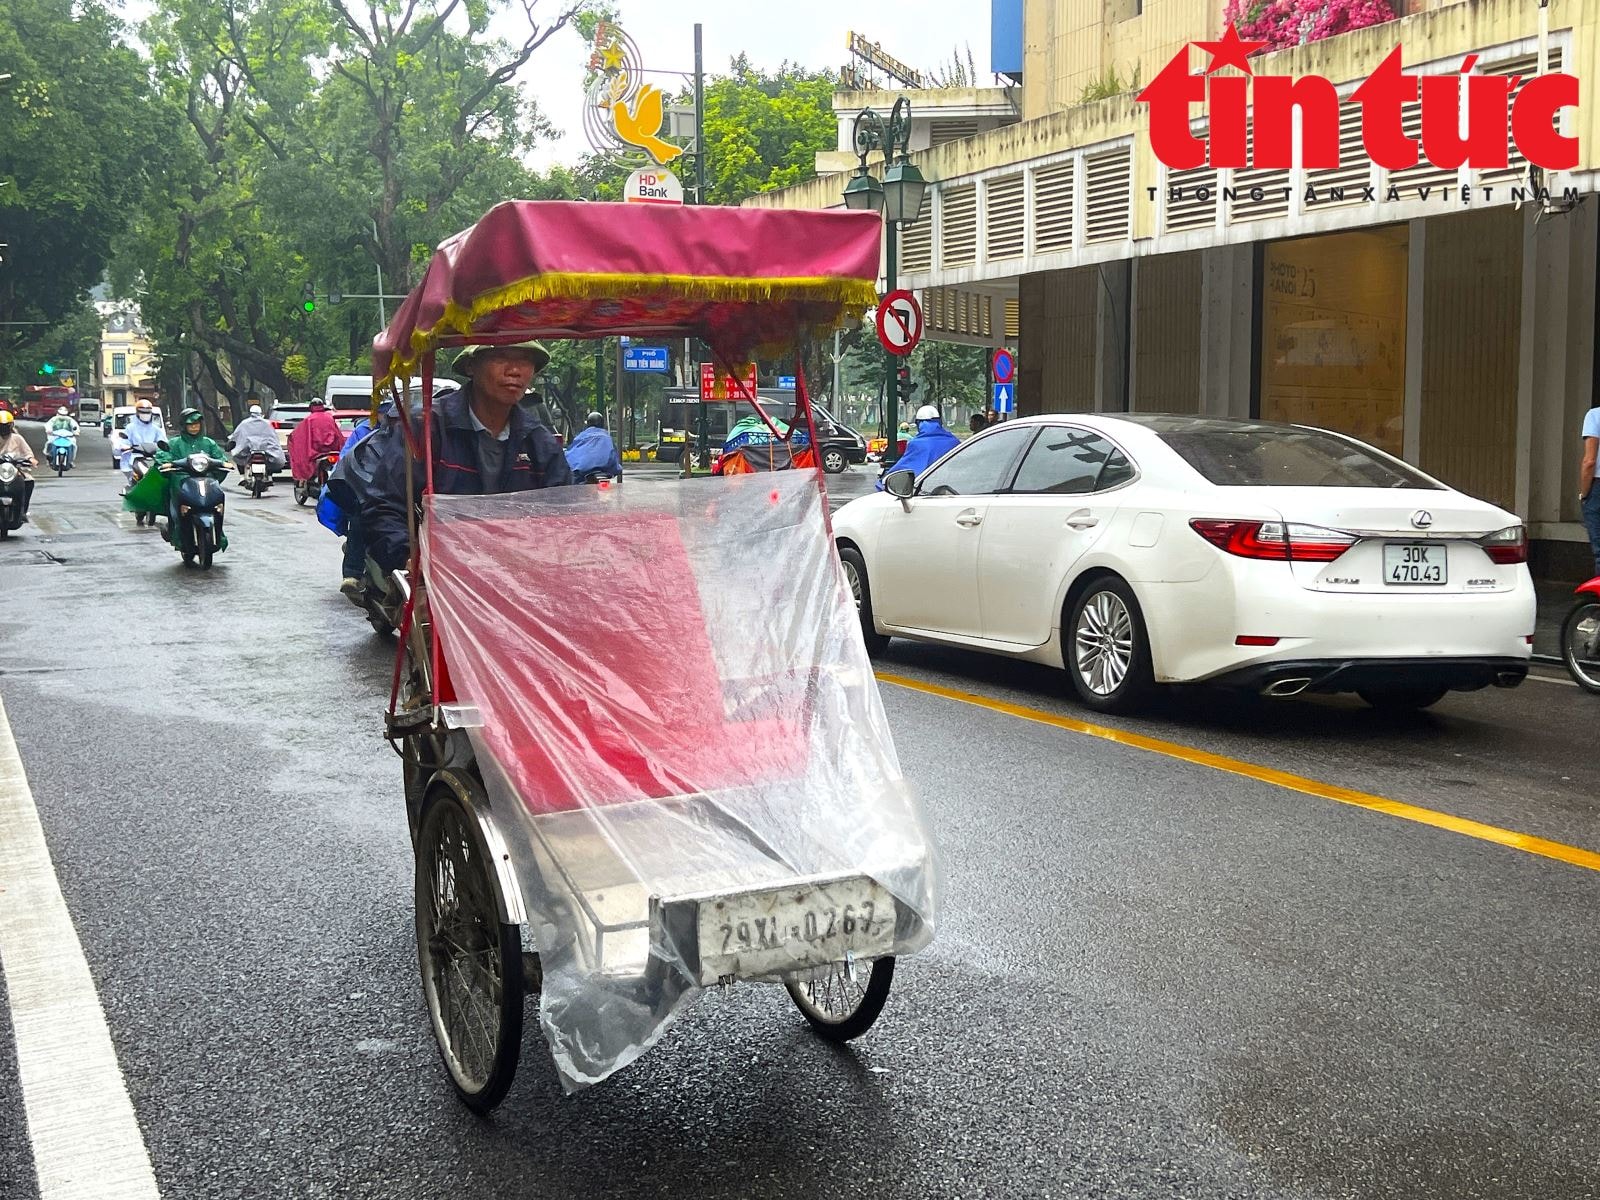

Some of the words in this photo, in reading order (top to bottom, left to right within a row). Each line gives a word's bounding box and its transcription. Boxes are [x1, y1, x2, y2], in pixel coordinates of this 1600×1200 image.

[639, 174, 656, 186] HD
[639, 186, 668, 198] Bank
[1402, 546, 1429, 564] 30K
[1392, 565, 1441, 582] 470.43
